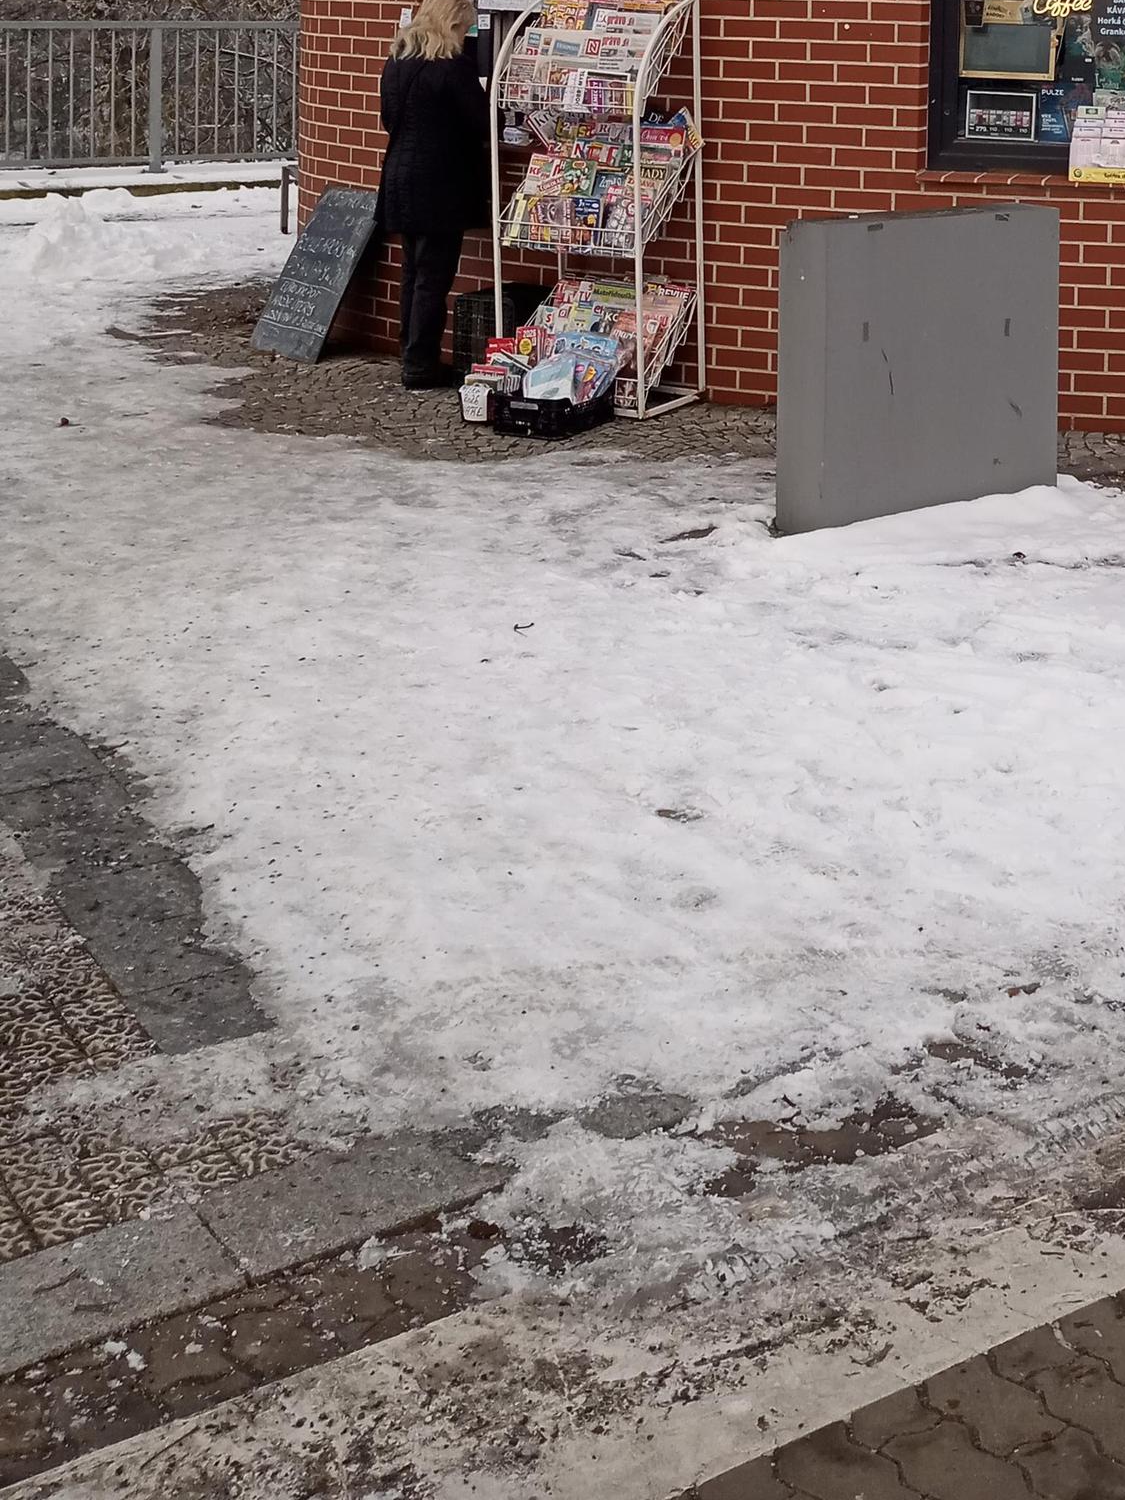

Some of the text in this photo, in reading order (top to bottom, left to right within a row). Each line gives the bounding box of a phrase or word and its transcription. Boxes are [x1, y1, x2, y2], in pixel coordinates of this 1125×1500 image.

[1098, 16, 1122, 26] Horká
[1041, 88, 1065, 96] PULZE
[657, 286, 690, 303] REVUE
